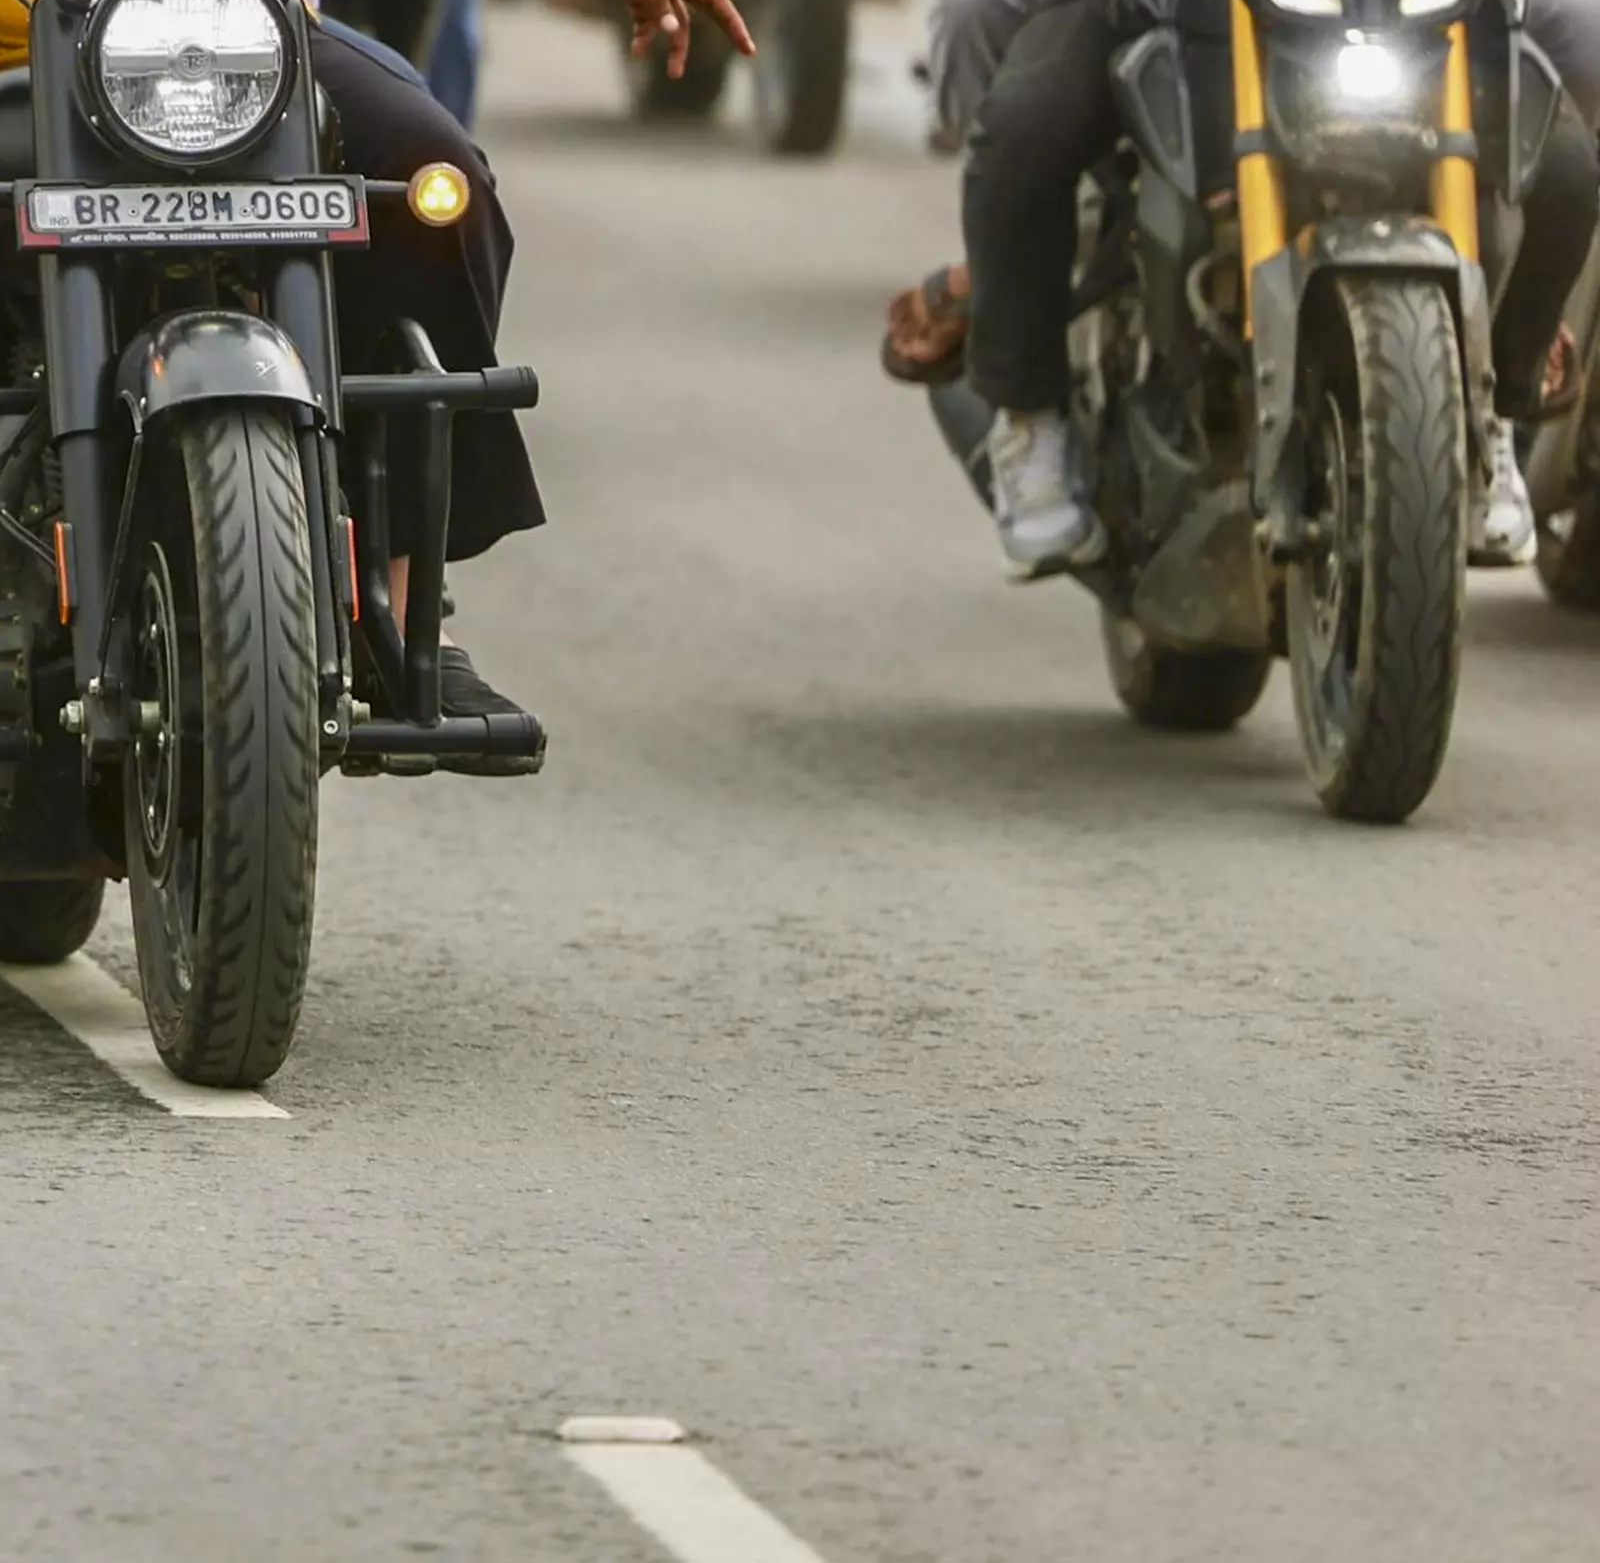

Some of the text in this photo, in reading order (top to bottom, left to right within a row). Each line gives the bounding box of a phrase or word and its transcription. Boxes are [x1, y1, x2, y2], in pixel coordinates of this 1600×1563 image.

[73, 193, 121, 225] BR
[141, 189, 233, 223] 22BM
[250, 190, 346, 222] 0606
